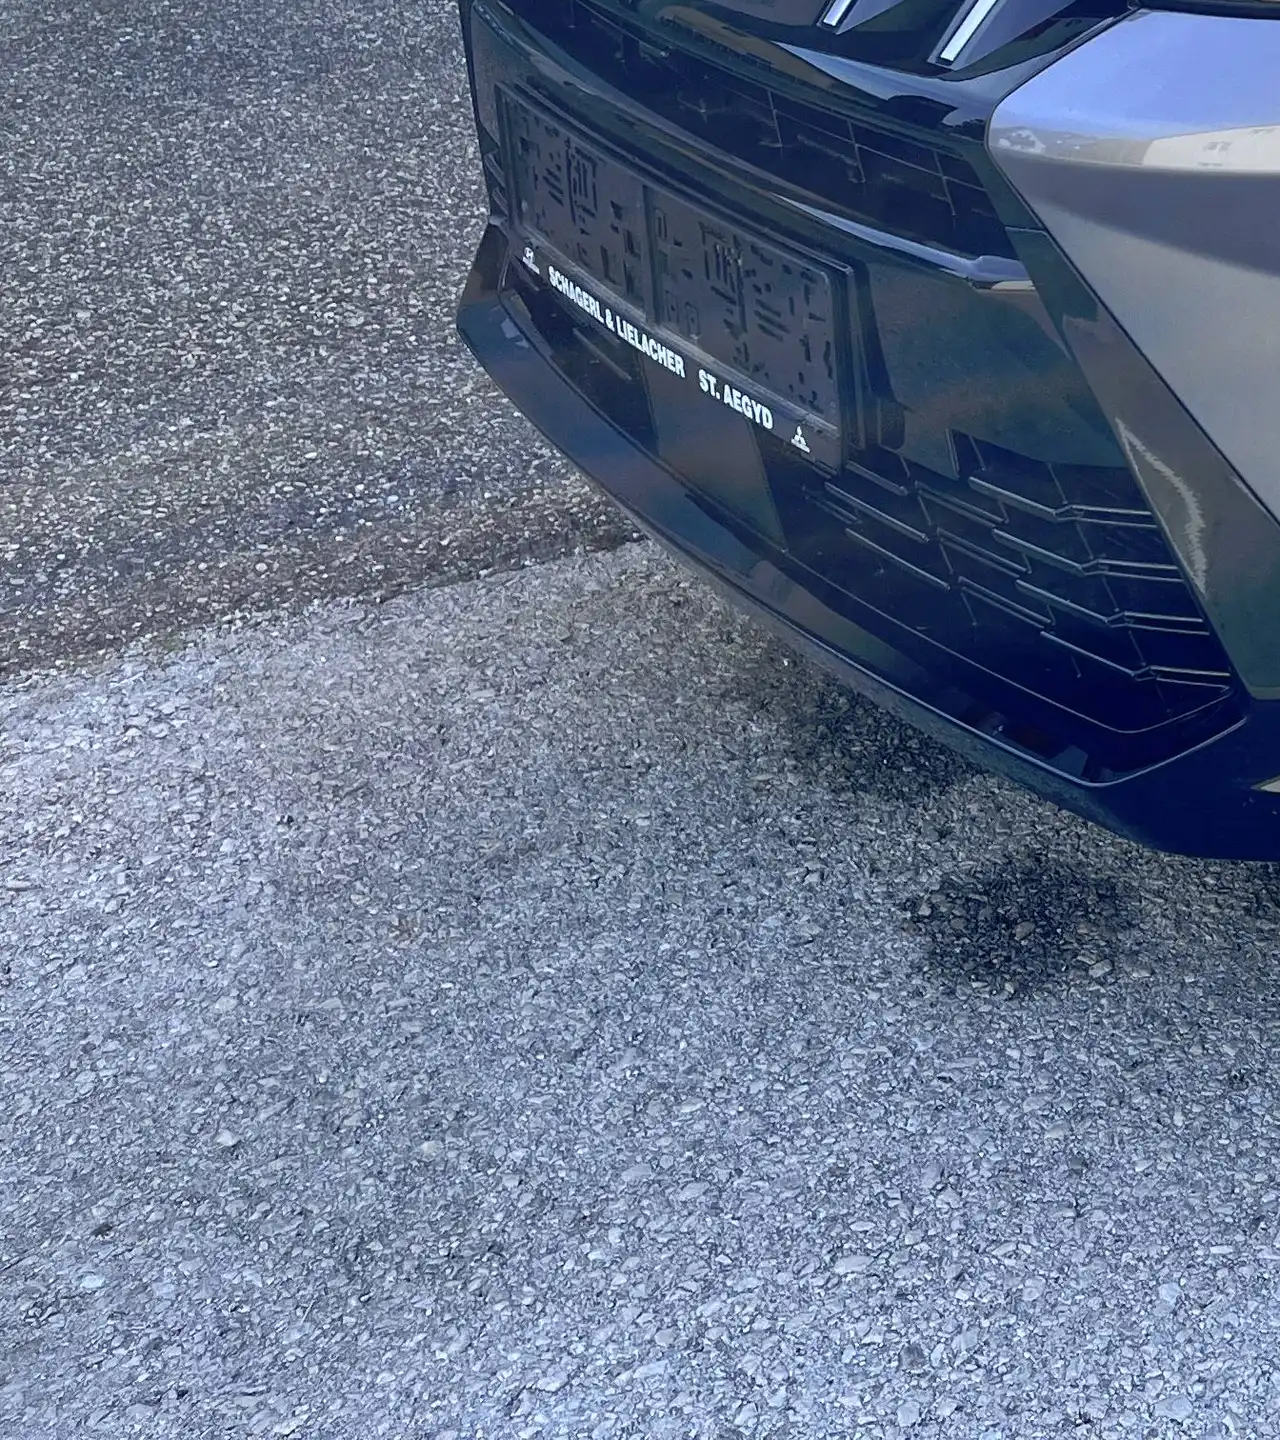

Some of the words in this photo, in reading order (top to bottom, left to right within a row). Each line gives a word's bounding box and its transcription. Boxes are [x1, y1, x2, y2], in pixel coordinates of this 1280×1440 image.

[548, 265, 605, 324] SCHAGERL
[605, 308, 615, 332] &
[616, 315, 686, 378] LIELACHER
[699, 368, 721, 400] ST.
[723, 384, 774, 429] AEGYD
